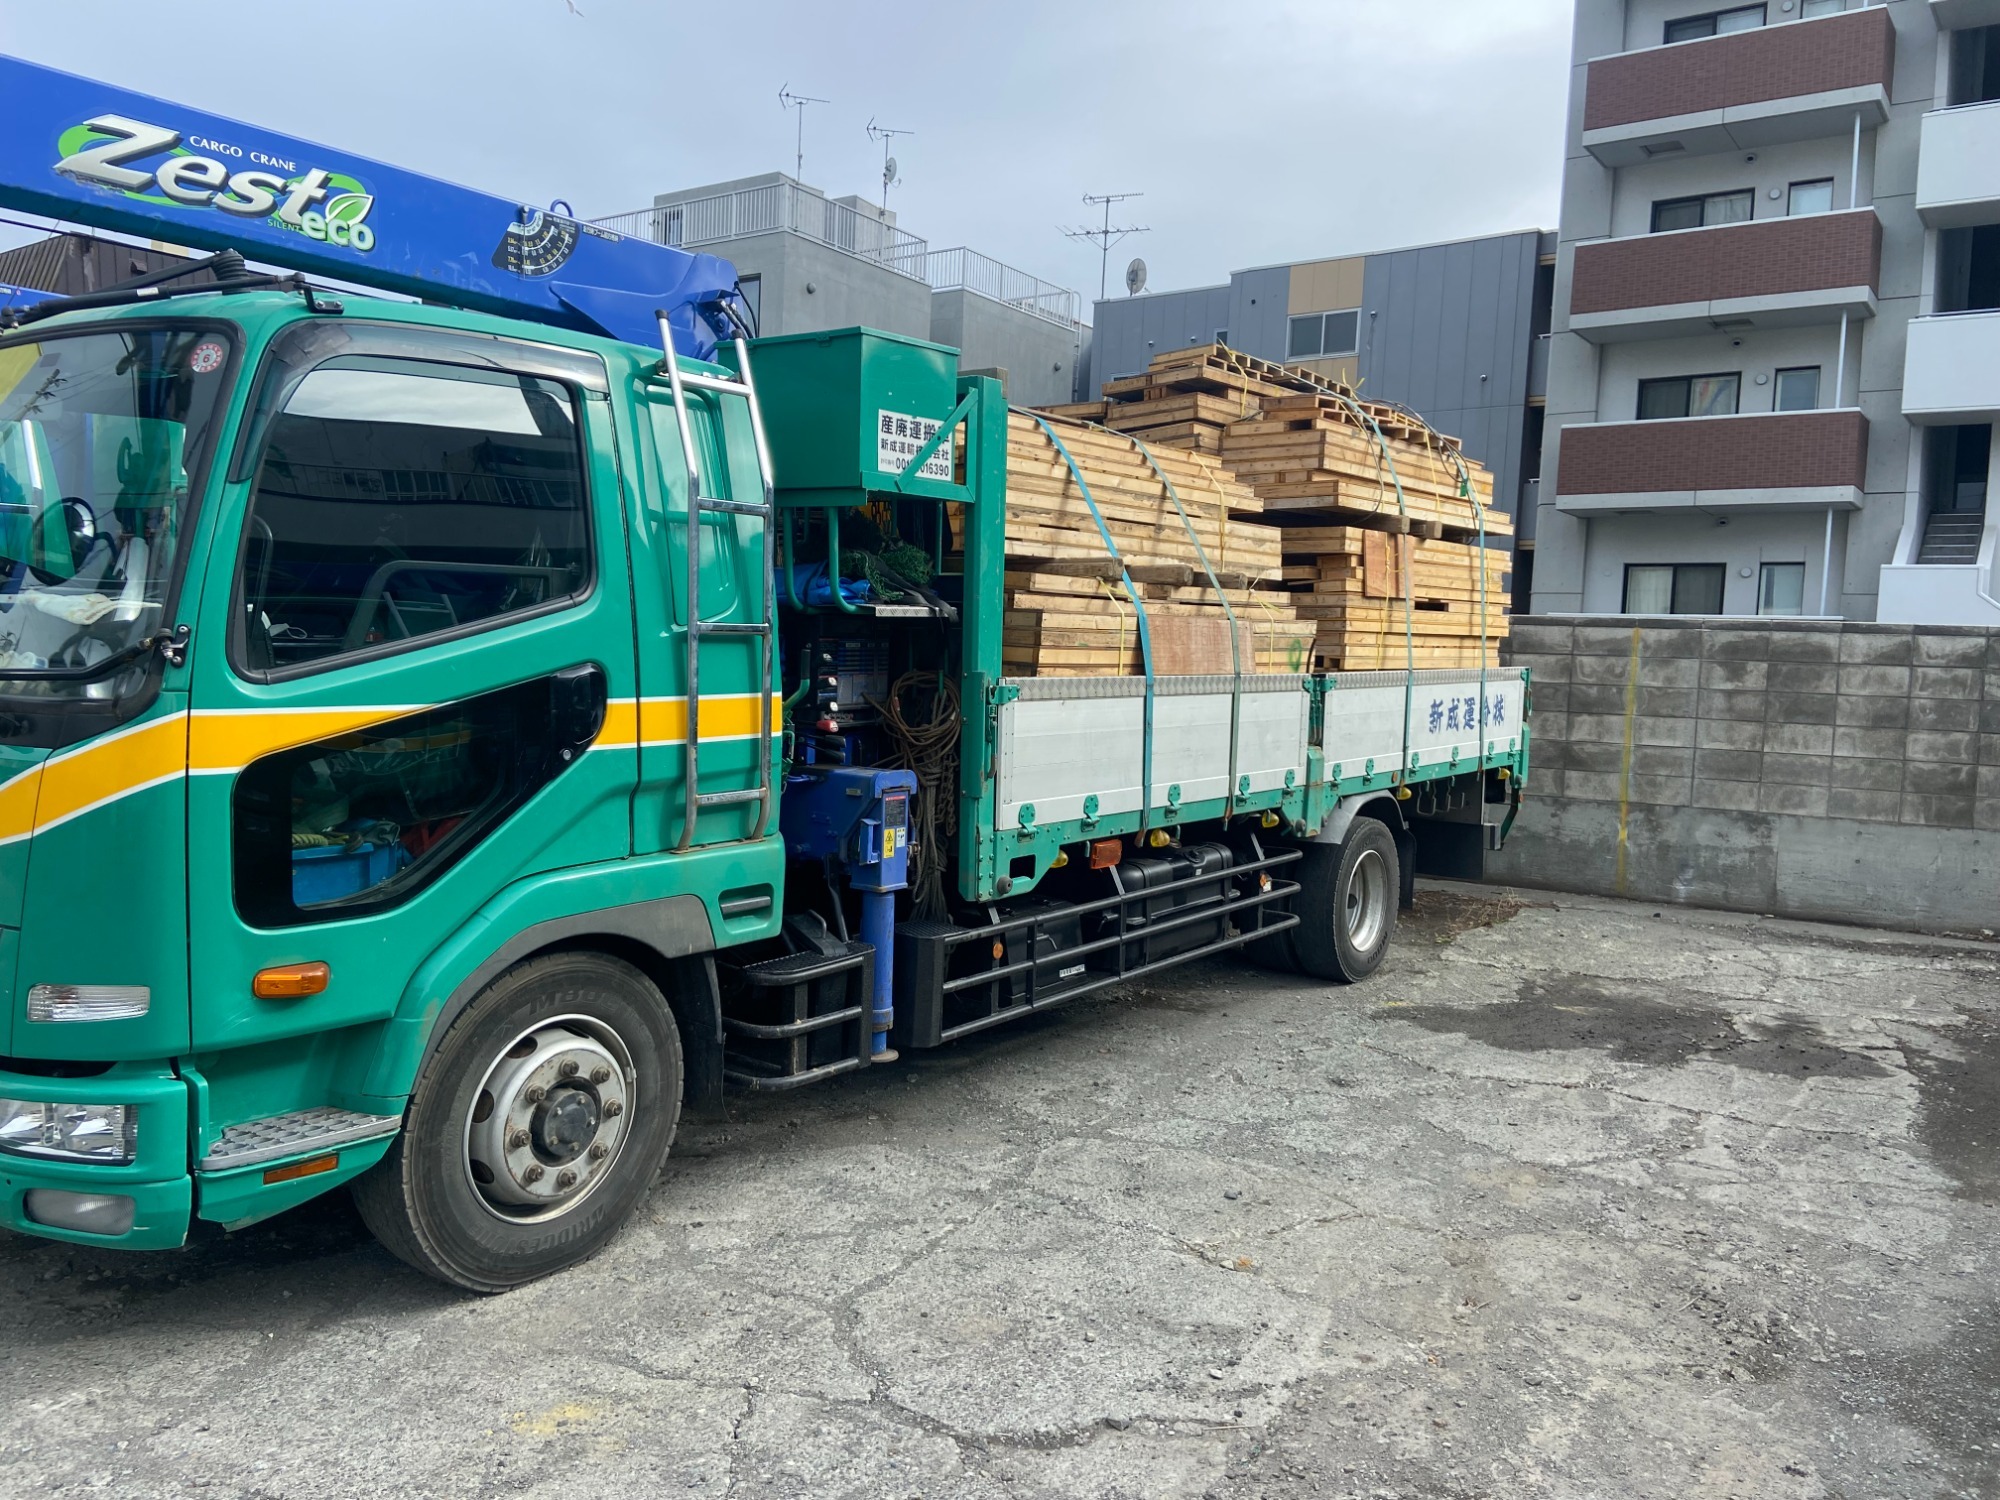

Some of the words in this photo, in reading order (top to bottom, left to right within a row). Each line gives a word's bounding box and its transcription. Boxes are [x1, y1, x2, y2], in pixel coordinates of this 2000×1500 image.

[52, 113, 331, 222] Zest
[189, 135, 243, 158] CARGO
[250, 151, 297, 173] CRANE
[301, 211, 376, 252] eco
[881, 438, 949, 461] 新成運輸株会社
